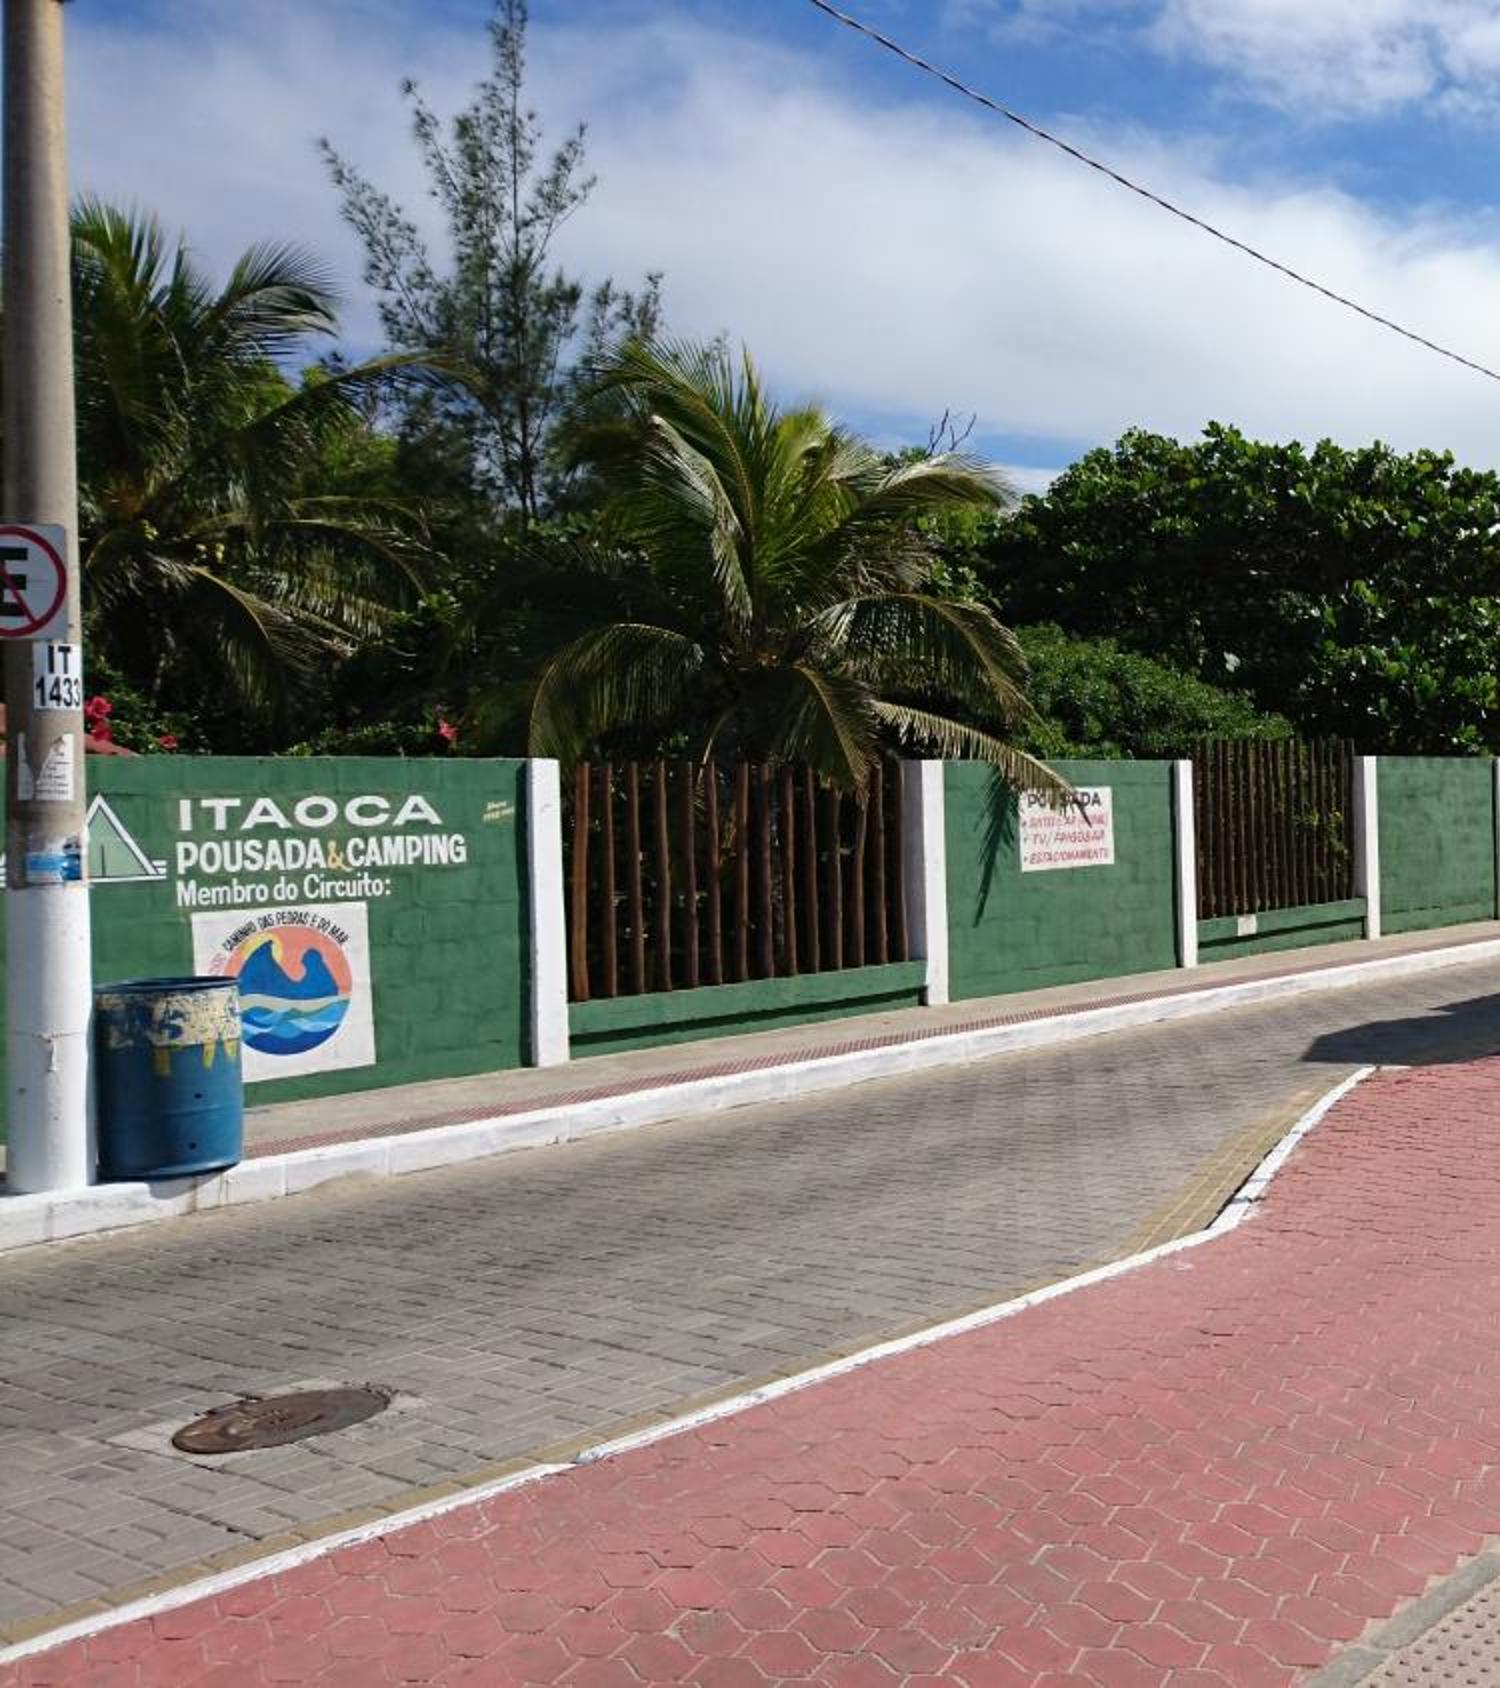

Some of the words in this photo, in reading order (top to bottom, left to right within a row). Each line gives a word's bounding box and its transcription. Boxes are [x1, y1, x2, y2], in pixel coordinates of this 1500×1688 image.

[47, 645, 71, 674] IT
[35, 676, 81, 707] 1433
[178, 795, 443, 832] ITAOCA
[176, 837, 326, 875] POUSADA
[346, 834, 467, 868] CAMPING
[176, 878, 268, 907] Membro
[273, 877, 298, 900] do
[303, 872, 391, 899] Circuito:
[257, 913, 275, 931] DAS
[275, 911, 309, 926] PEDRAS
[317, 918, 332, 931] DO
[328, 926, 350, 945] MAR
